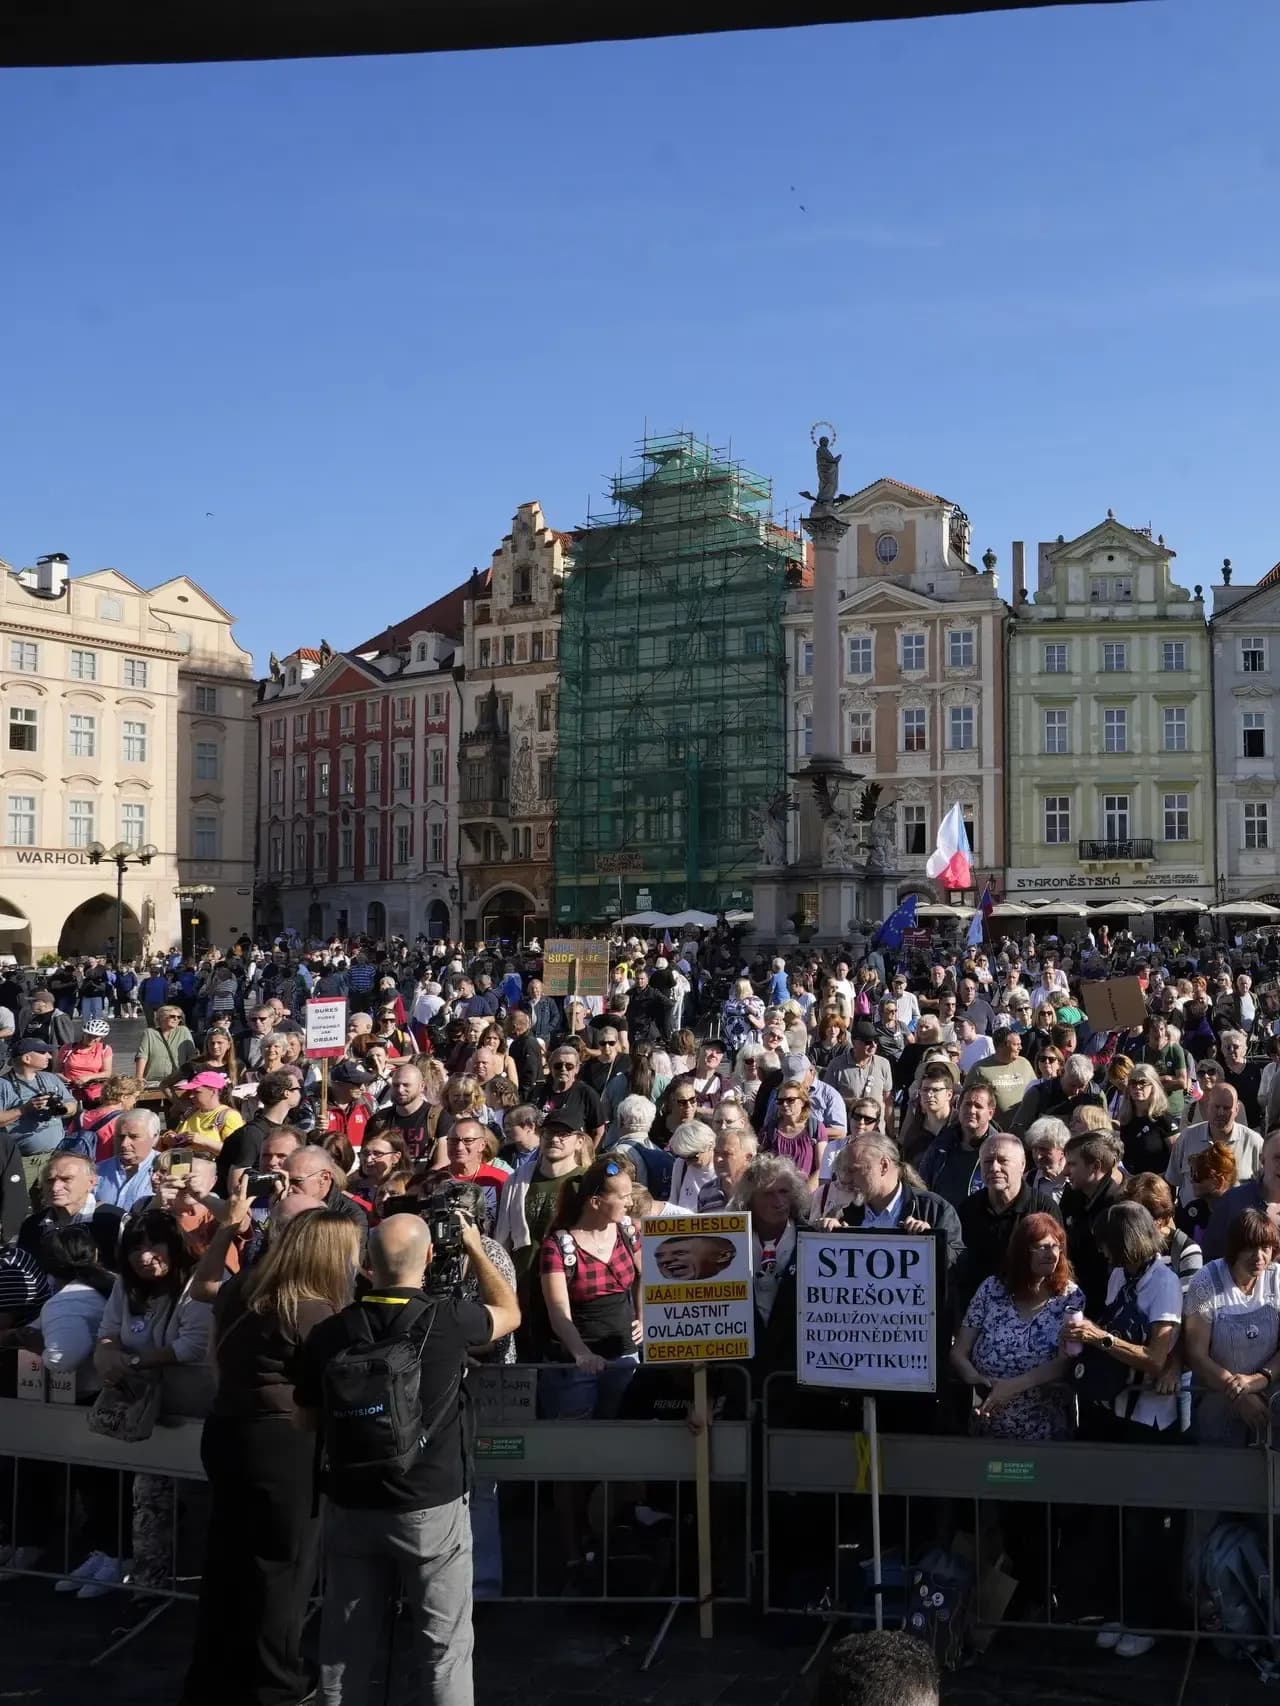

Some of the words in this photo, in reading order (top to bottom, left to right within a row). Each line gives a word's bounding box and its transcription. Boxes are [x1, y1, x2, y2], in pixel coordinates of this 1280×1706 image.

[16, 851, 87, 865] WARHOL
[1016, 872, 1121, 888] STAROMĚSTSKÁ
[645, 1221, 686, 1234] MOJE
[690, 1216, 745, 1231] HESLO:
[817, 1247, 920, 1280] STOP
[685, 1284, 746, 1299] NEMUSÍM
[806, 1282, 926, 1306] BUREŠOVĚ
[664, 1304, 730, 1320] VLASTNIT
[806, 1310, 928, 1326] ZADLUŽOVACÍMU
[648, 1322, 711, 1338] OVLÁDAT
[714, 1321, 747, 1336] CHCI
[806, 1327, 929, 1343] RUDOHNĚDÉMU
[648, 1343, 700, 1359] ČERPAT
[705, 1341, 747, 1355] CHCI!!
[806, 1350, 928, 1369] PANOPTIKU!!!
